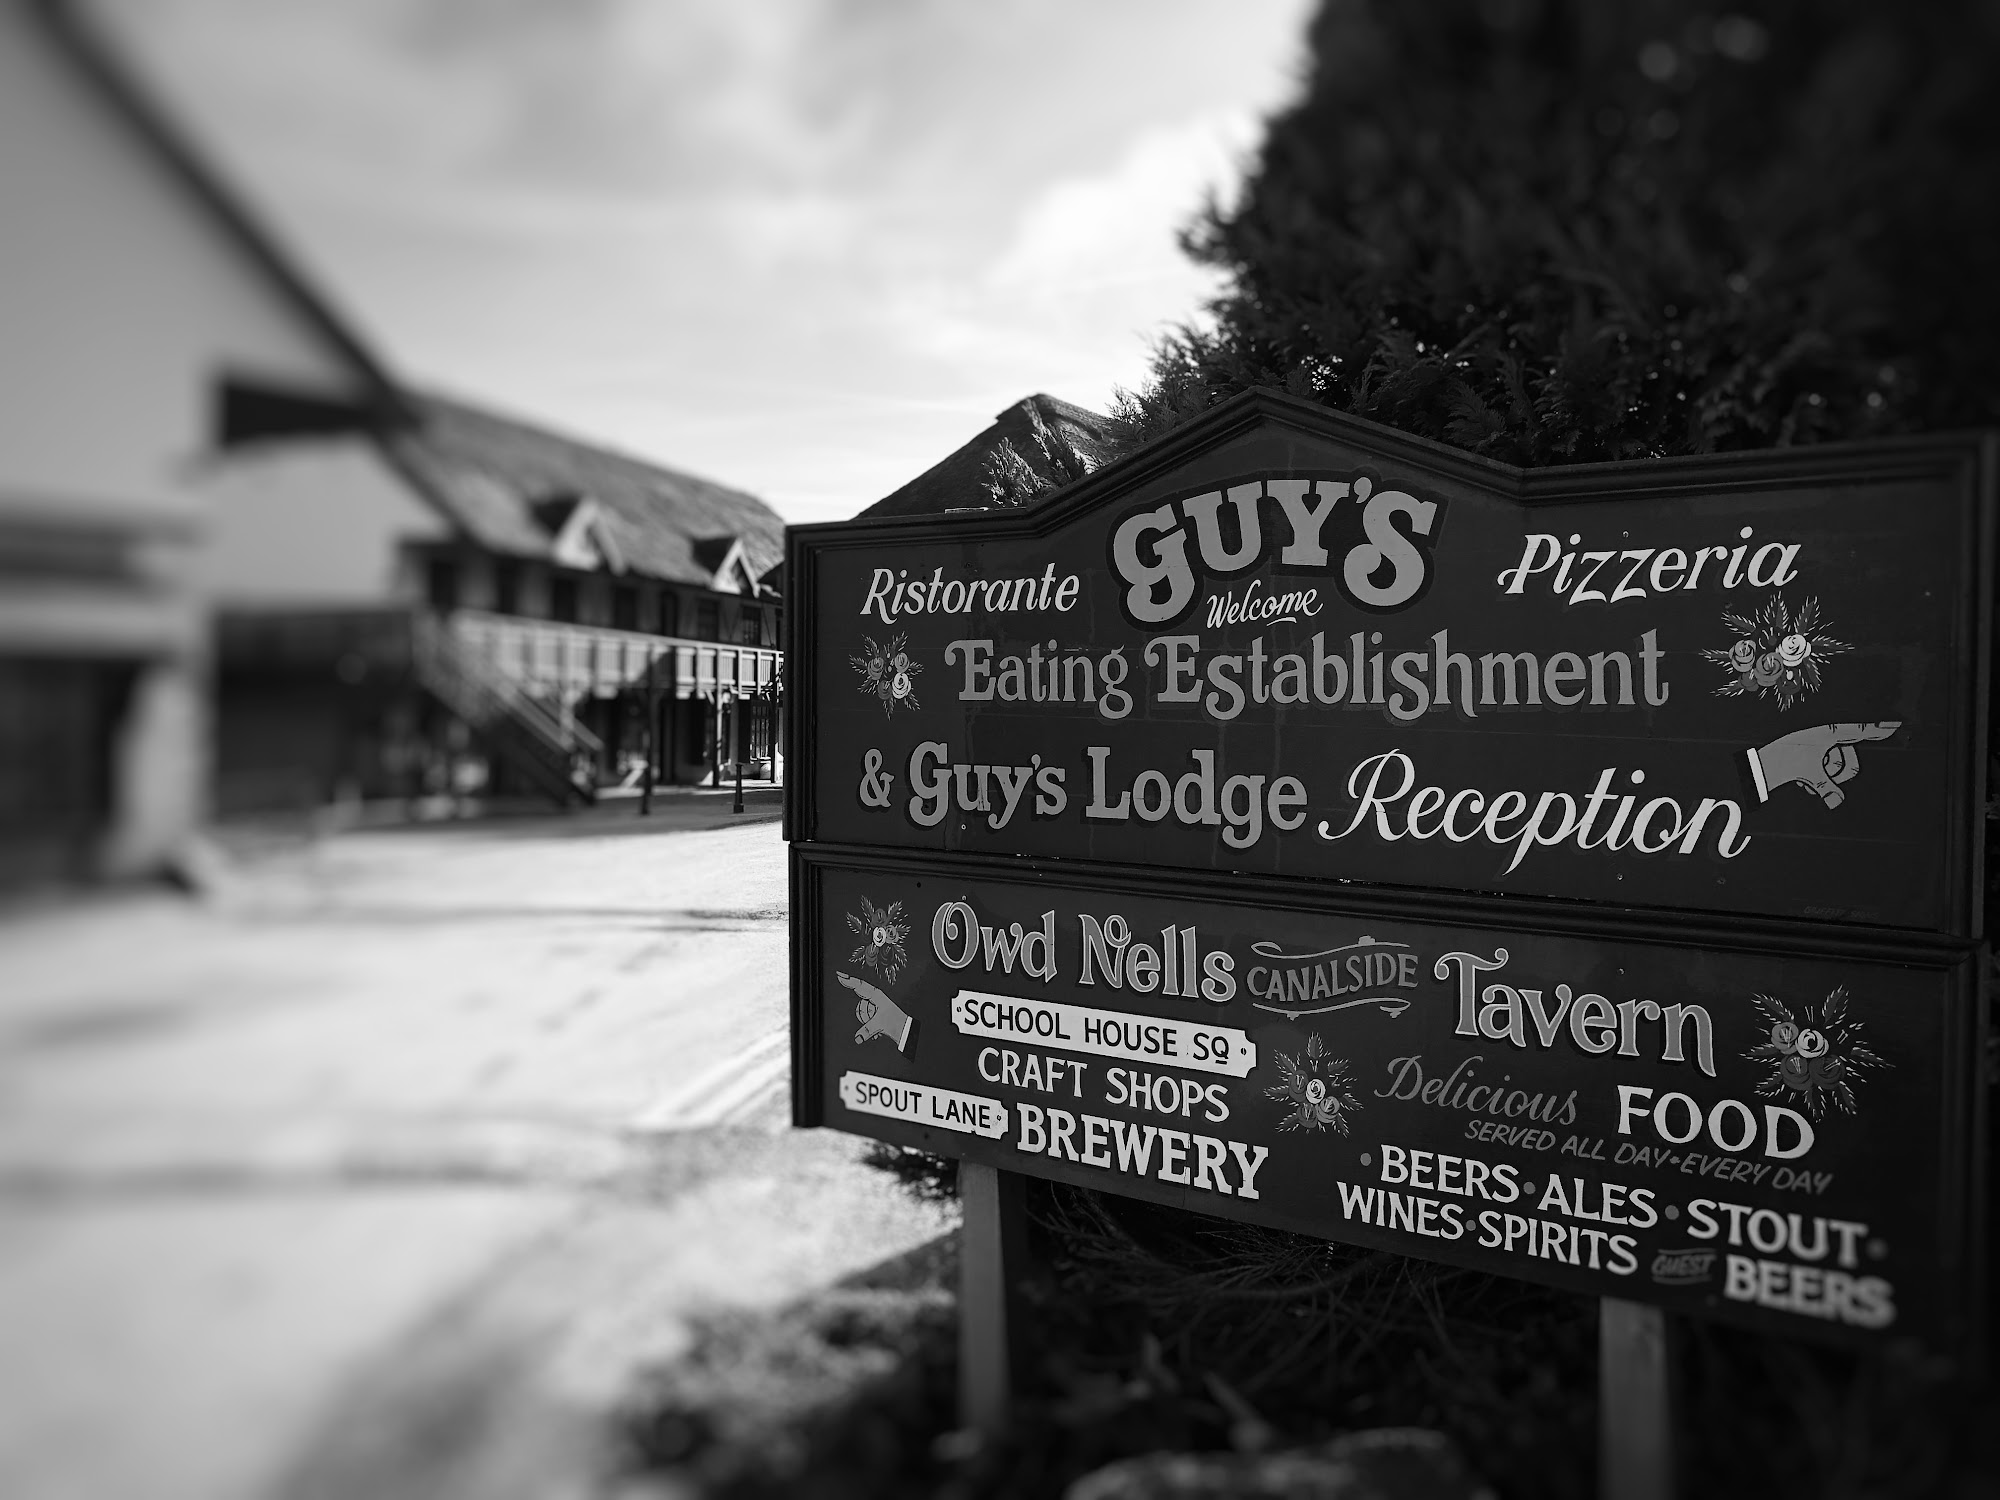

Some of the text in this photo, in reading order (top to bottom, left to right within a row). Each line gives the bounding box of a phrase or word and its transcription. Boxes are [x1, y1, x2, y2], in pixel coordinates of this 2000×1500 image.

[859, 562, 1080, 624] Ristorante
[1112, 476, 1438, 623] GUY'S
[1496, 526, 1801, 606] Pizzeria
[1204, 579, 1324, 624] Welcome
[944, 629, 1669, 722] Eating Establishment
[859, 740, 1752, 876] & Guy's Lodge Reception
[931, 901, 1717, 1078] Owd Nells CANALSIDE Tavern
[964, 999, 1071, 1041] SCHOOL
[1084, 1019, 1179, 1057] HOUSE
[855, 1080, 991, 1129] SPOUT LANE
[977, 1046, 1230, 1123] CRAFT SHOPS
[1374, 1055, 1815, 1159] Delicious FOOD
[1016, 1101, 1269, 1200] BREWERY
[1464, 1119, 1833, 1195] SERVED ALL DAY EVERY DAY
[1379, 1144, 1869, 1269] BEERS ALES STOUT
[1336, 1181, 1897, 1331] WINES SPIRITS GUEST BEERS
